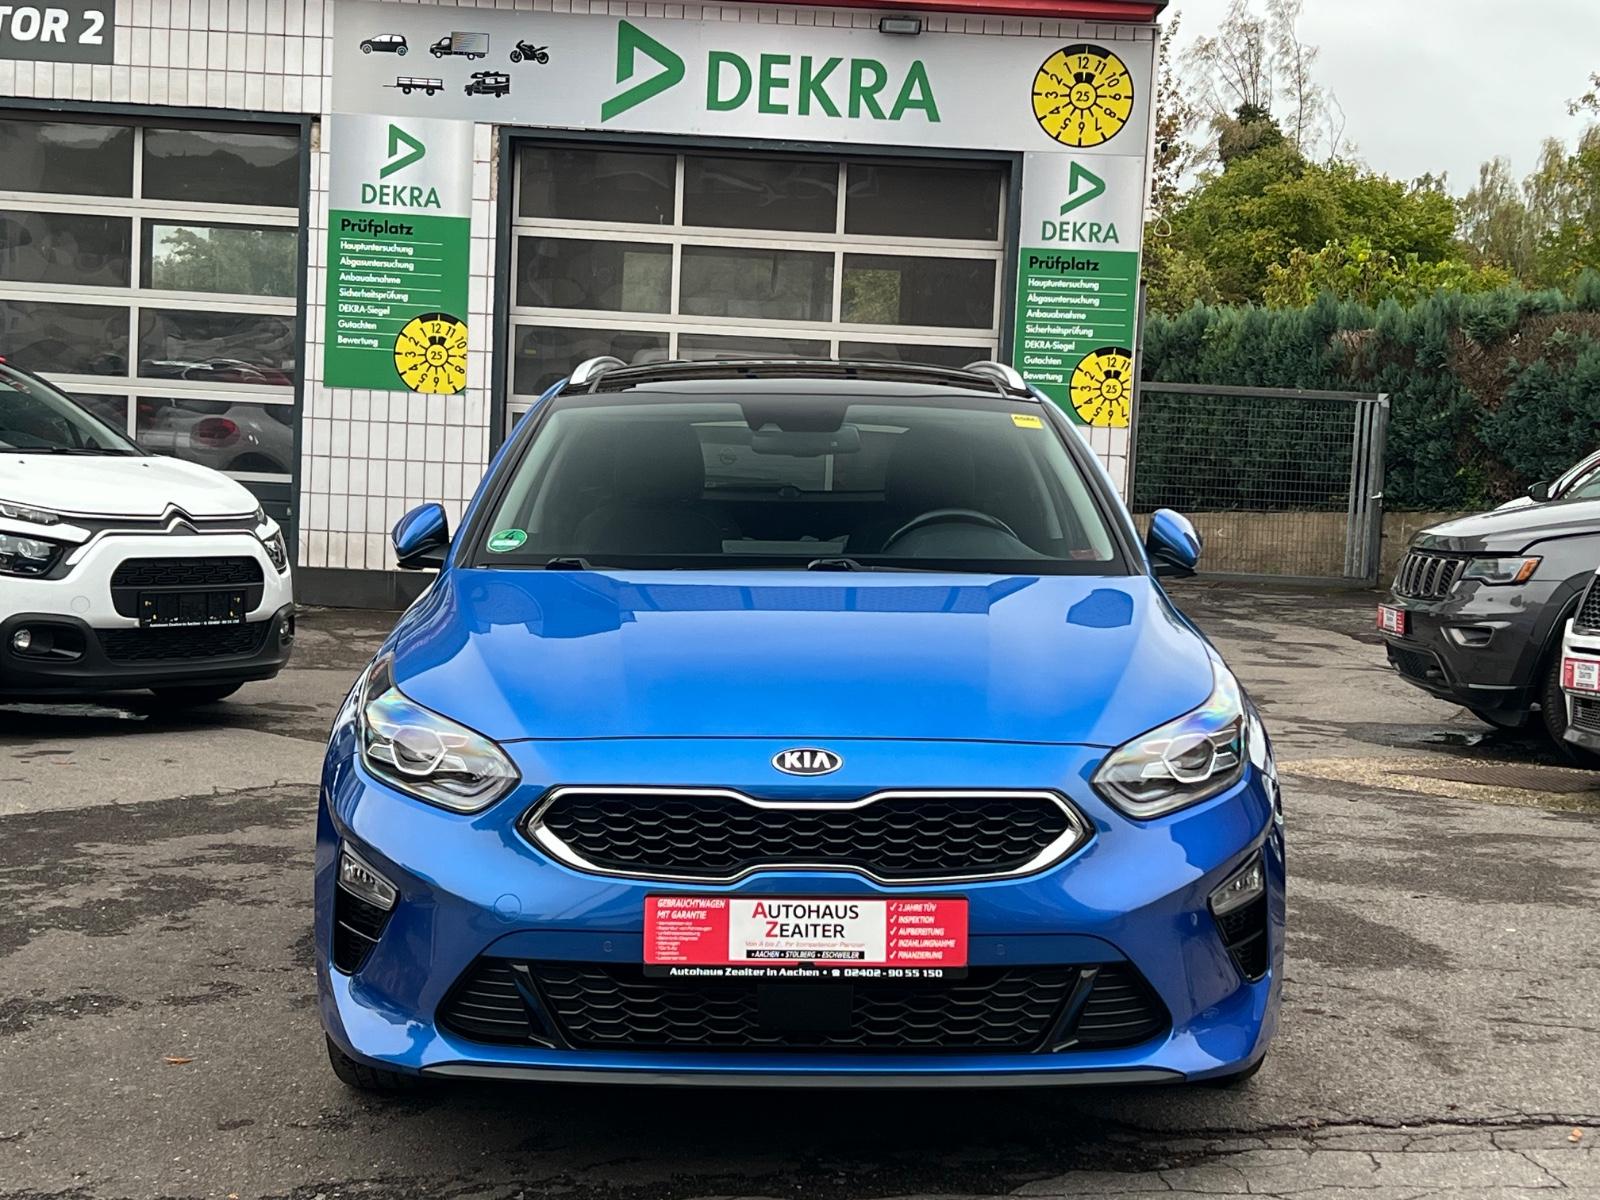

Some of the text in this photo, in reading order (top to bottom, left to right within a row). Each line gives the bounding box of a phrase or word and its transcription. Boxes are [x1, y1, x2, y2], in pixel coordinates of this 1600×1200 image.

[78, 10, 105, 45] 2
[706, 50, 941, 123] DEKRA
[1045, 56, 1122, 135] 1 12 11 10 9 8 7 6 5 4 3 2
[1076, 91, 1090, 102] 25
[361, 183, 441, 208] DEKRA
[341, 218, 414, 237] Prüfplatz
[1041, 220, 1119, 244] DEKRA
[340, 241, 414, 255] Hauptuntersuchung
[340, 256, 414, 271] Abgasuntersuchung
[1029, 256, 1100, 274] Prüfplatz
[339, 272, 401, 284] Anbauabnahme
[1028, 278, 1099, 291] Hauptuntersuchung
[339, 288, 409, 302] Sicherheitsprüfung
[1027, 293, 1100, 307] Abgasuntersuchung
[338, 303, 390, 317] DEKRA-Siegel
[1026, 309, 1086, 320] Anbauabnahme
[338, 320, 377, 330] Gutachten
[431, 323, 441, 334] 12
[1025, 325, 1094, 337] Sicherheitsprüfung
[420, 327, 427, 338] 1
[445, 326, 456, 339] 11
[337, 335, 379, 347] Bewertung
[408, 336, 419, 346] 2
[455, 336, 467, 349] 10
[1024, 341, 1075, 352] DEKRA-Siegel
[430, 351, 442, 360] 25
[1024, 356, 1062, 365] Gutachten
[454, 365, 465, 374] 8
[418, 373, 428, 384] 5
[433, 377, 439, 387] 6
[447, 373, 453, 385] 7
[1023, 371, 1063, 383] Bewertung
[1105, 385, 1117, 394] 25
[784, 751, 831, 769] KIA
[657, 898, 725, 909] GEBRAUCHTWAGEN
[657, 910, 707, 920] MIT GARANTIE
[752, 902, 859, 919] AUTOHAUS
[898, 915, 935, 924] INSPEKTION
[765, 921, 845, 938] ZEAITER
[898, 927, 944, 936] AUFBEREITUNG
[670, 967, 723, 976] Autohaus
[725, 967, 765, 976] Zeaiter
[767, 968, 777, 976] in
[779, 968, 820, 977] Aachen
[905, 969, 919, 978] 55
[923, 969, 943, 978] 150
